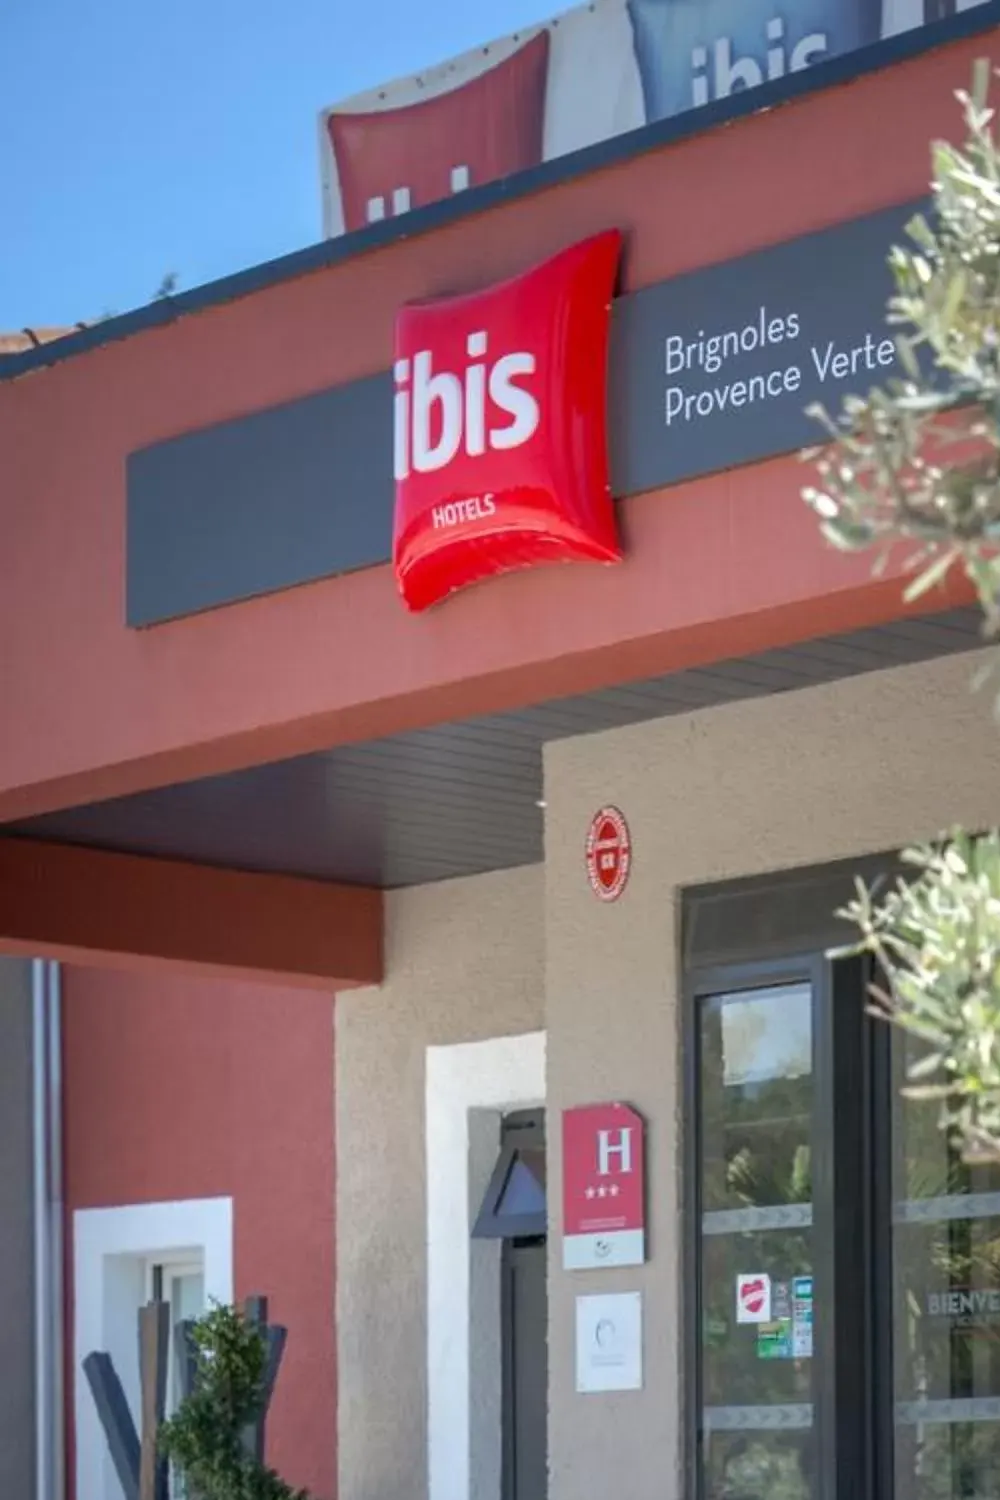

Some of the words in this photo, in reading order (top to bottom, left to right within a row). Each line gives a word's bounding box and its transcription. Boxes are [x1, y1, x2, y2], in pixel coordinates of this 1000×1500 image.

[665, 306, 800, 374] Brignoles
[394, 329, 541, 481] ibis
[665, 366, 801, 426] Provence
[811, 333, 895, 383] Verte
[431, 493, 496, 529] HOTELS
[597, 1128, 633, 1175] H
